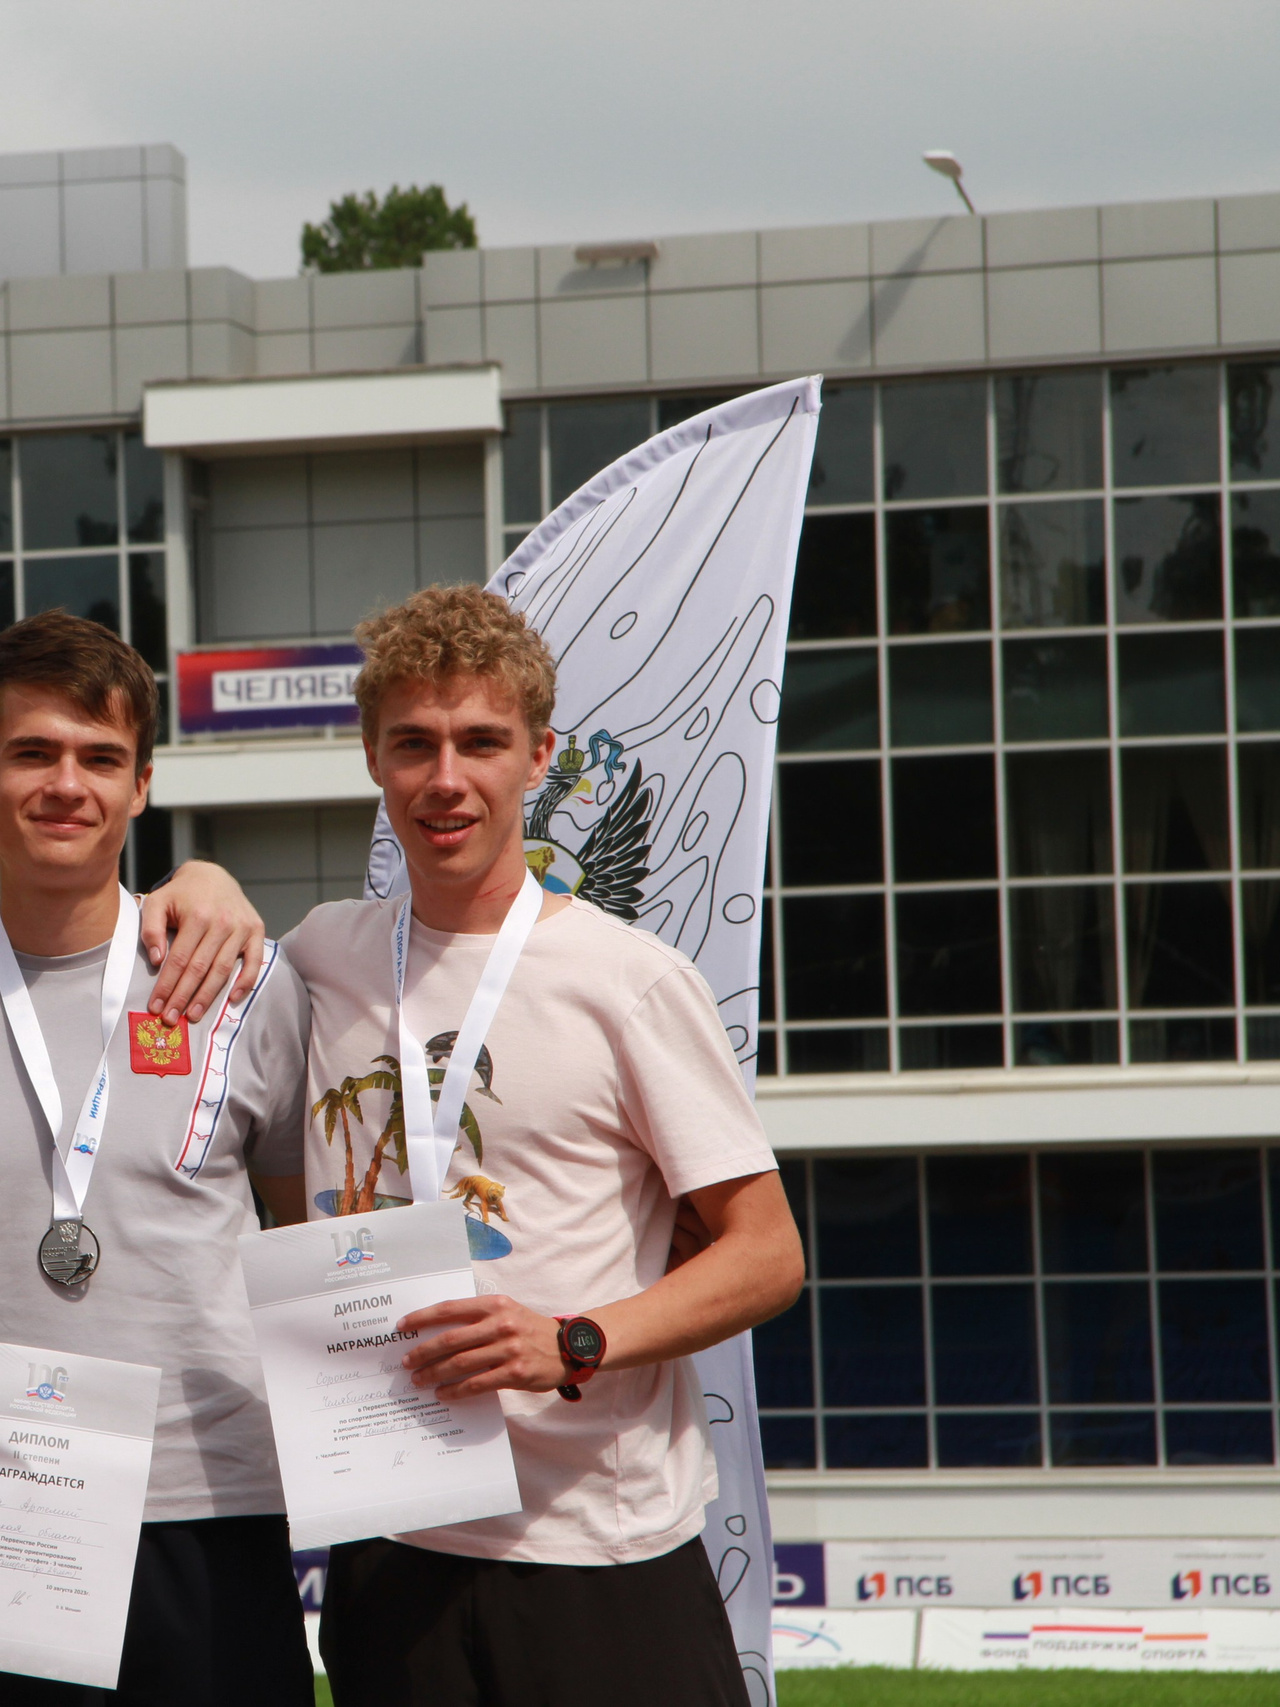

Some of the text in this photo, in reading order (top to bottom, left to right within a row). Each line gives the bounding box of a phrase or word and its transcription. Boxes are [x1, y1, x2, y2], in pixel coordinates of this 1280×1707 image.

[334, 1294, 392, 1317] ДИПЛОМ
[342, 1316, 389, 1330] II степени
[327, 1329, 418, 1354] НАГРАЖДАЕТСЯ
[398, 1396, 419, 1405] России
[9, 1431, 69, 1450] ДИПЛОМ
[13, 1451, 60, 1465] II степени
[0, 1536, 36, 1547] Первенстве
[37, 1541, 58, 1549] России
[894, 1575, 954, 1596] ПСБ
[1051, 1574, 1111, 1596] ПСБ
[1211, 1574, 1271, 1596] ПСБ
